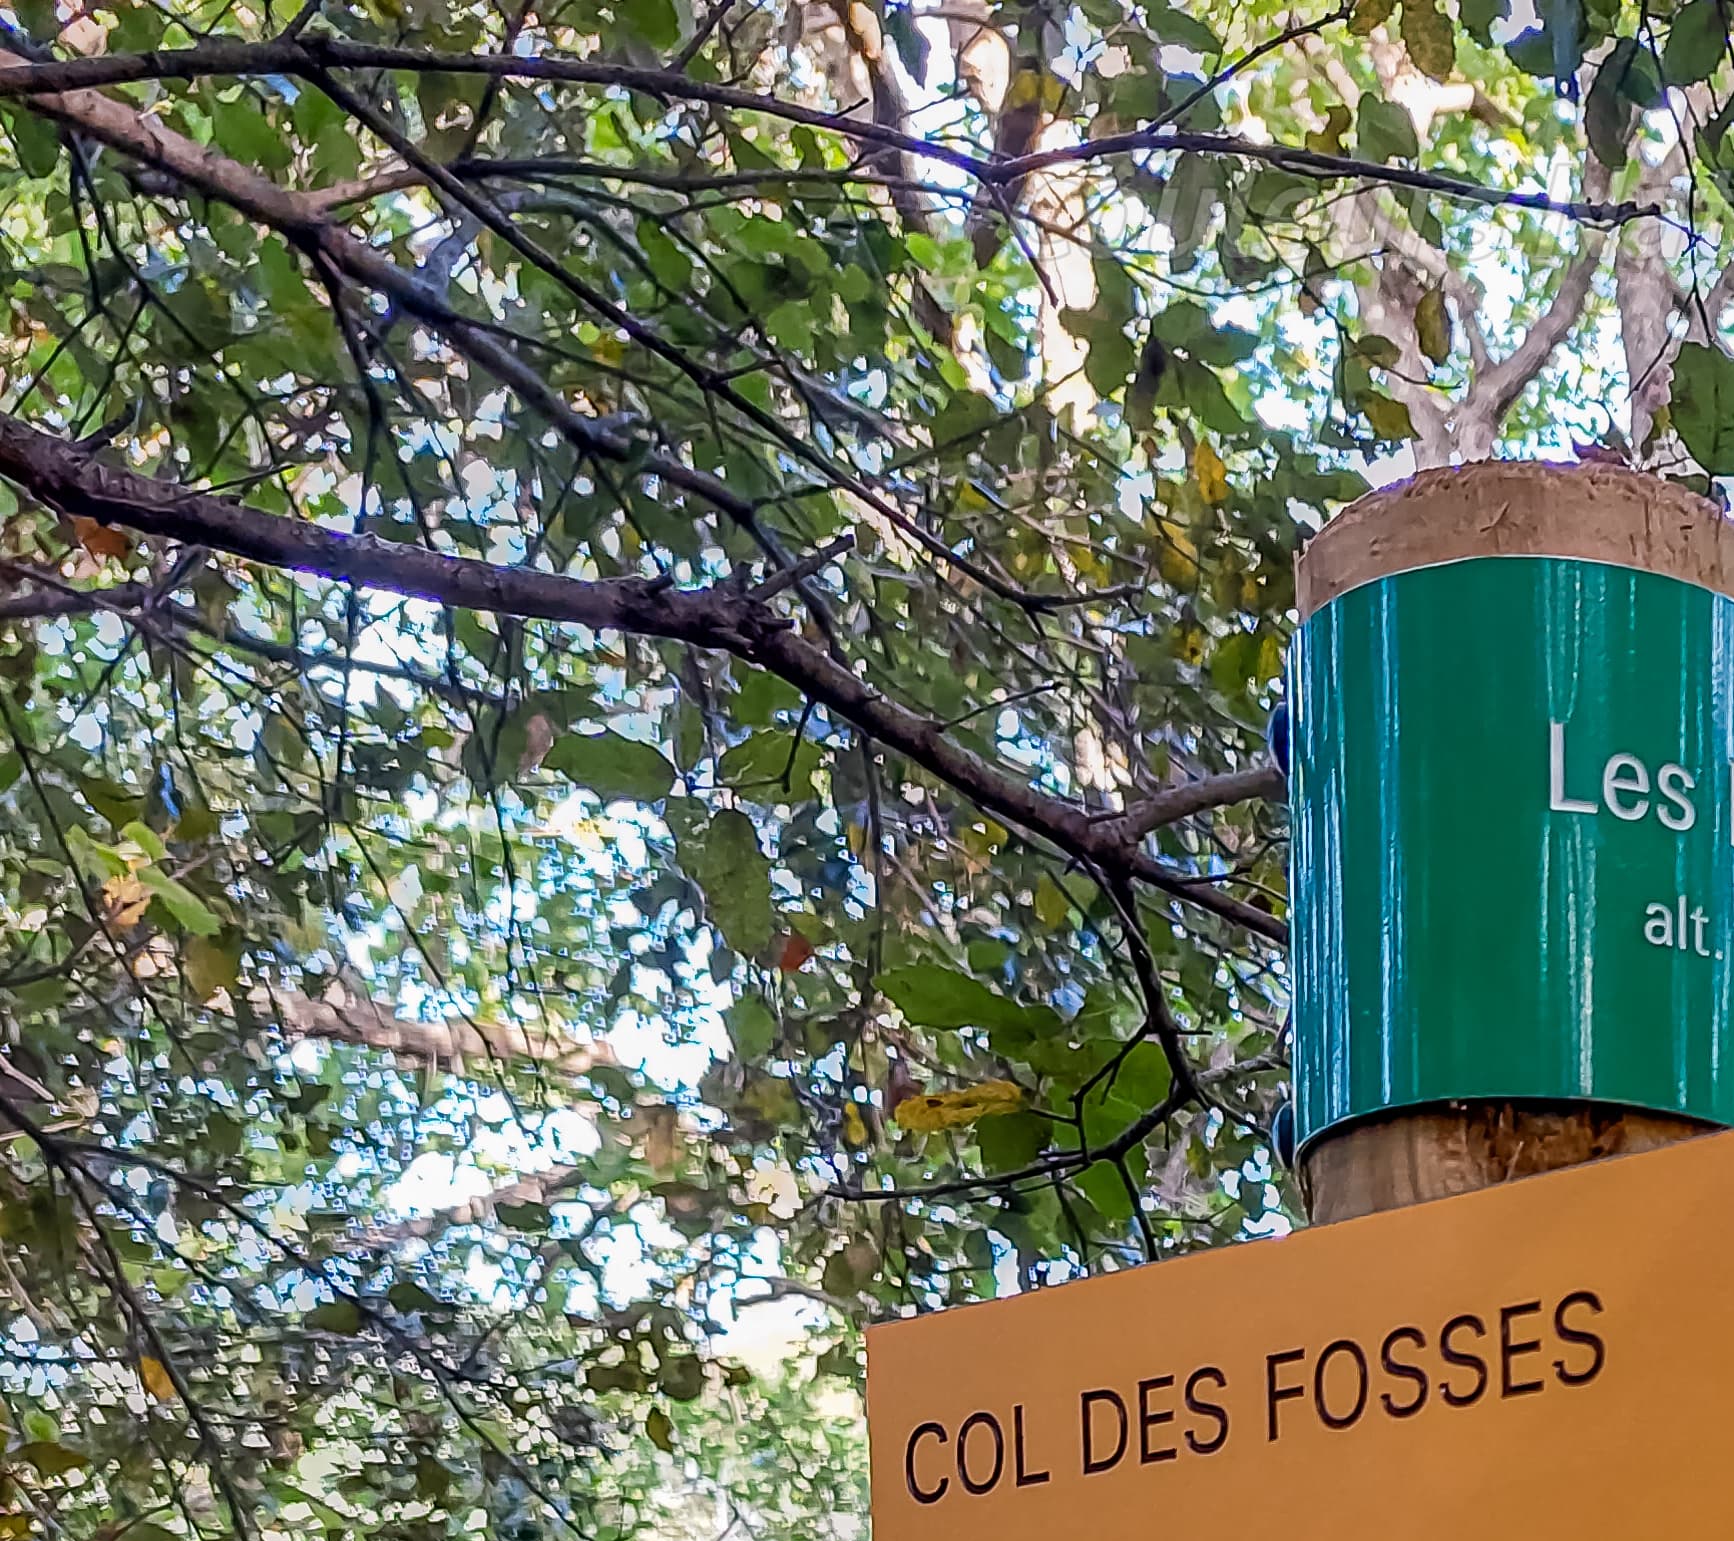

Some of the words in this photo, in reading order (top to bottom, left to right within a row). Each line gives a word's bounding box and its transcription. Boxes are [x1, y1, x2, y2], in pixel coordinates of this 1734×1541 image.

[1548, 719, 1698, 832] Les
[1643, 895, 1725, 962] alt.
[904, 1403, 1051, 1505] COL
[1079, 1366, 1230, 1476] DES
[1265, 1289, 1606, 1443] FOSSES
